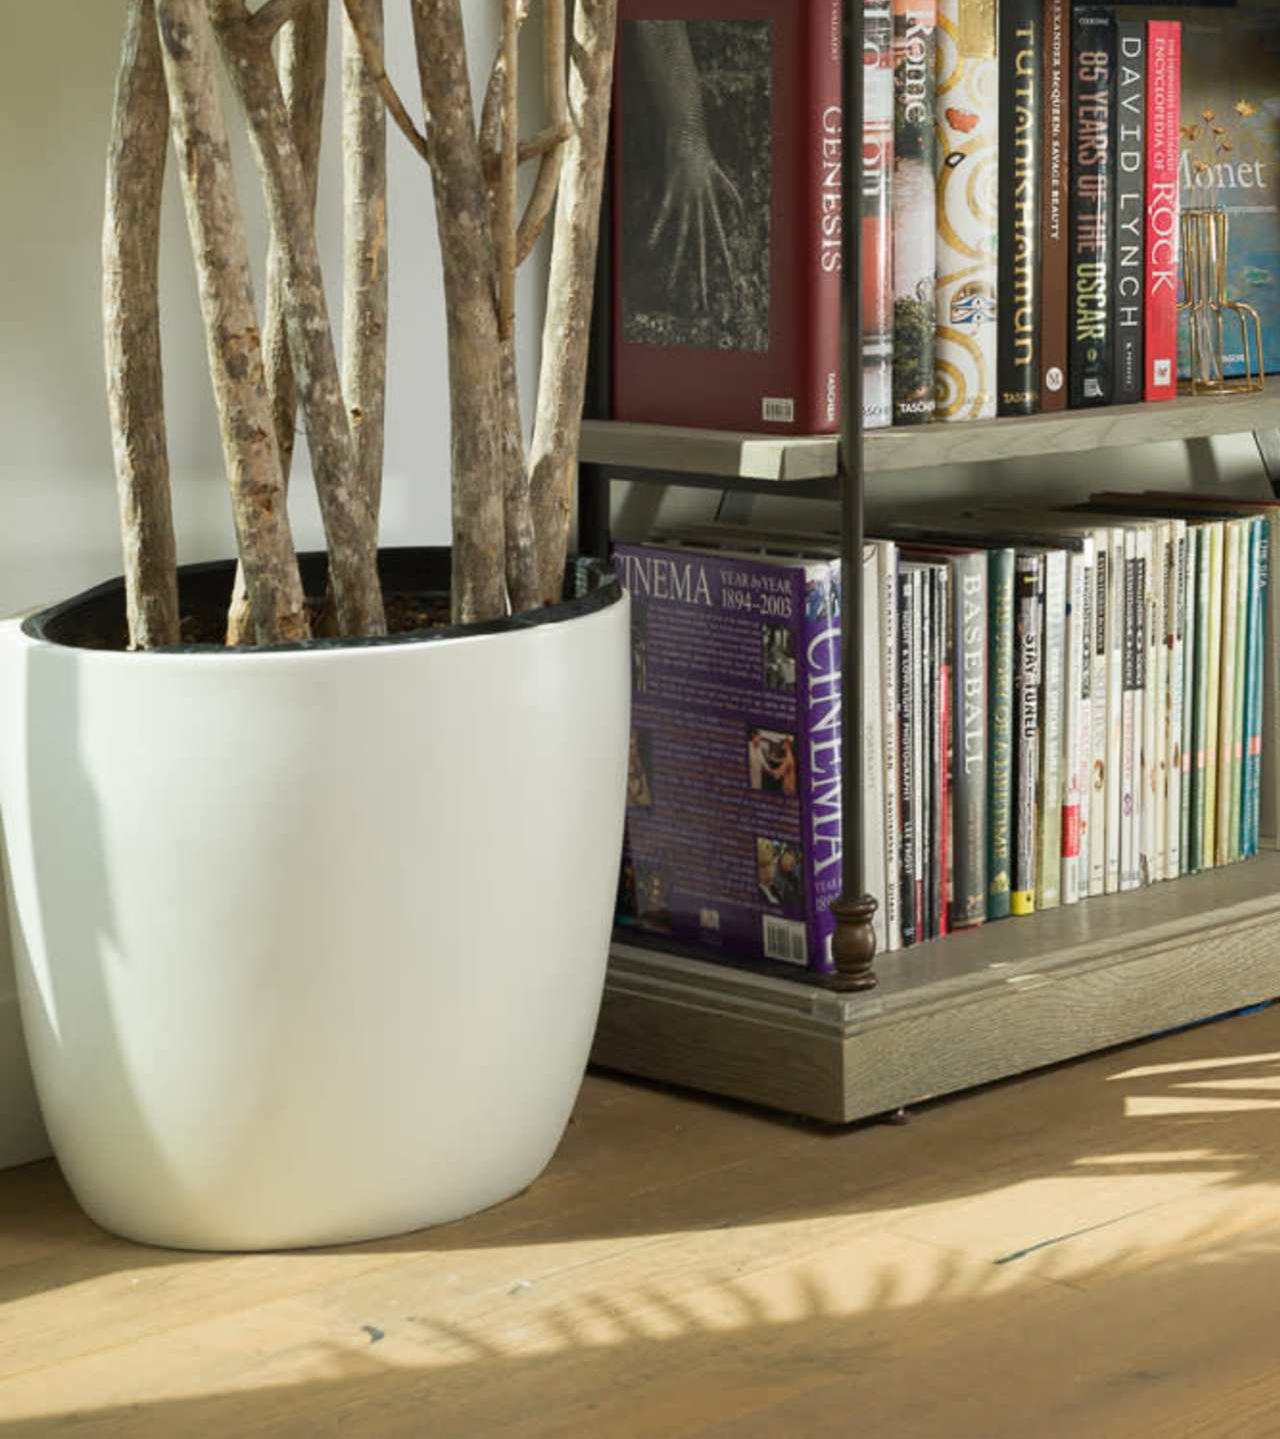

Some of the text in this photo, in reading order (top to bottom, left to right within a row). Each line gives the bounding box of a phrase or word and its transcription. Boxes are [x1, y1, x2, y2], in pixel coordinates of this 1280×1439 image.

[902, 9, 935, 123] Rome
[1078, 51, 1109, 81] 85
[1154, 38, 1166, 170] ENCYCLOPEDIA OF
[1051, 141, 1062, 186] SAVAGE
[1076, 91, 1109, 166] YEARS
[822, 106, 842, 273] GENESIS
[1050, 191, 1062, 240] BEAUTY
[1076, 175, 1108, 203] OF
[1119, 37, 1142, 327] DAVID LYNCH
[1076, 210, 1108, 254] THE
[1147, 182, 1178, 296] ROCK
[1076, 262, 1108, 341] OSCAR
[825, 372, 836, 423] TASCHEN
[720, 569, 793, 595] YEAR by YEAR
[963, 574, 984, 774] BASEBALL
[1024, 634, 1039, 740] STAY TUNED
[807, 627, 842, 878] CINEMA
[902, 723, 912, 801] PHOTOGRAPHY
[903, 822, 914, 840] LEE
[903, 843, 914, 875] FROST
